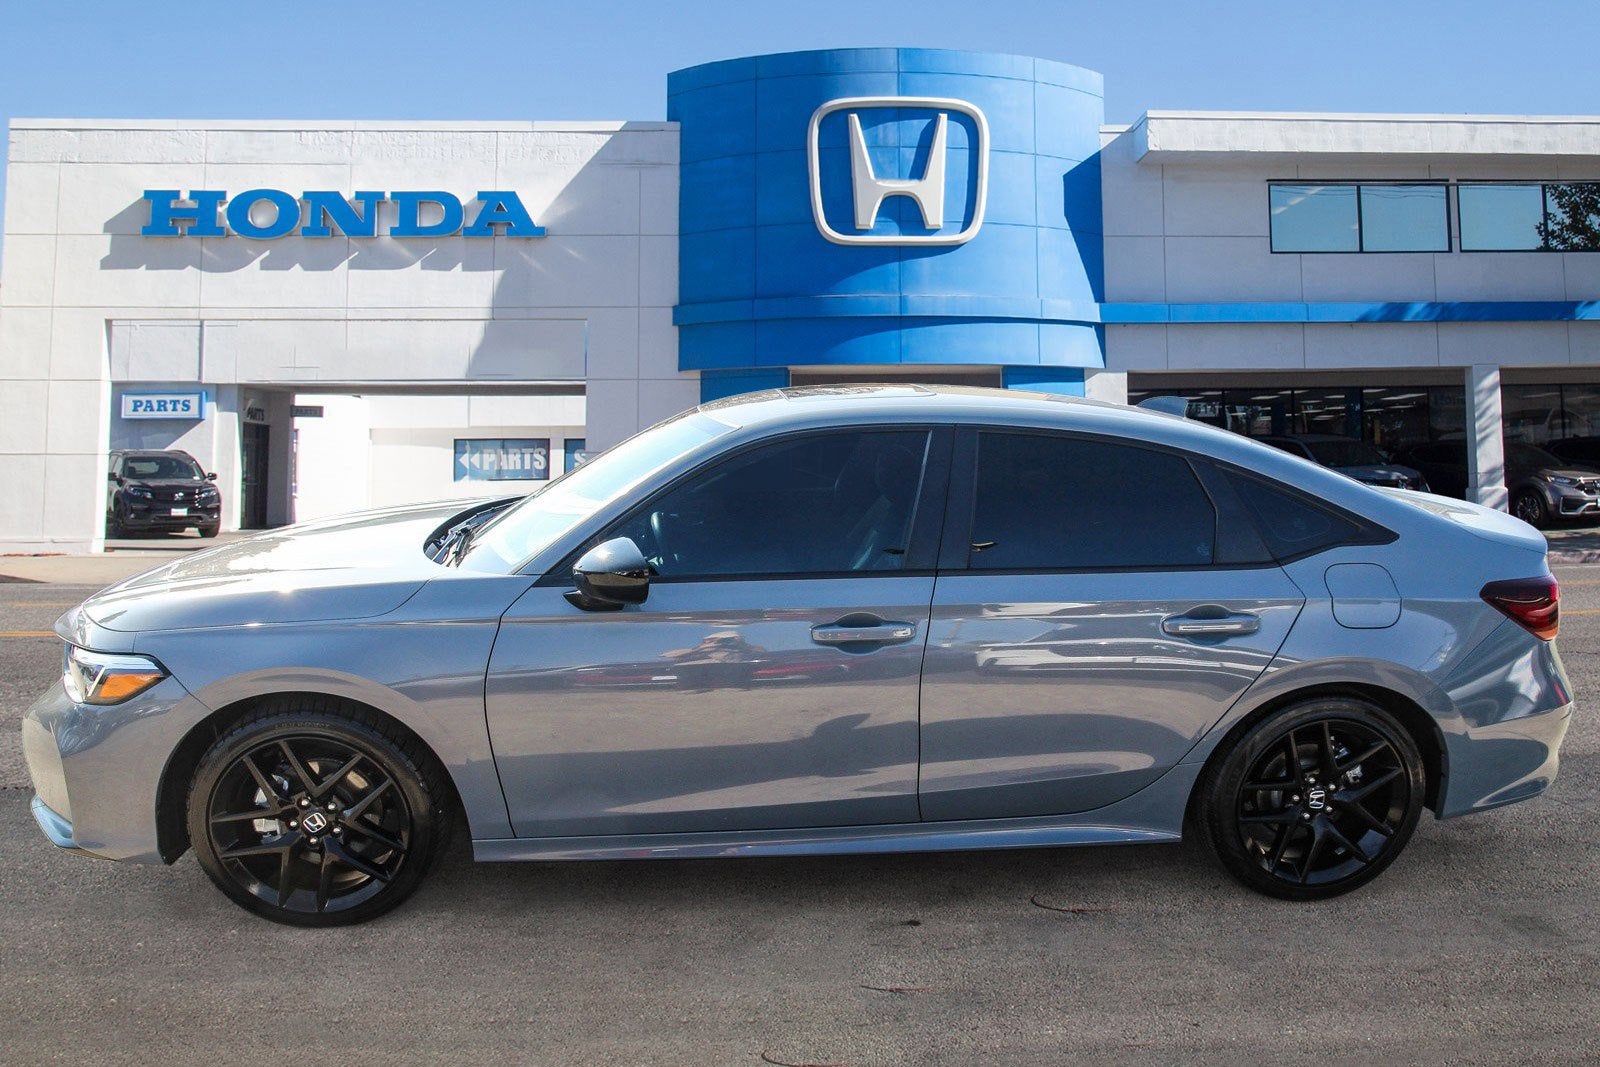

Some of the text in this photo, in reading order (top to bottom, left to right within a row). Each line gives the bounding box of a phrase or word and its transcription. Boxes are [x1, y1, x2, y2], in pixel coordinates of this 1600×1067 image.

[142, 189, 547, 239] HONDA
[132, 400, 191, 412] PARTS
[483, 448, 547, 470] PARTS
